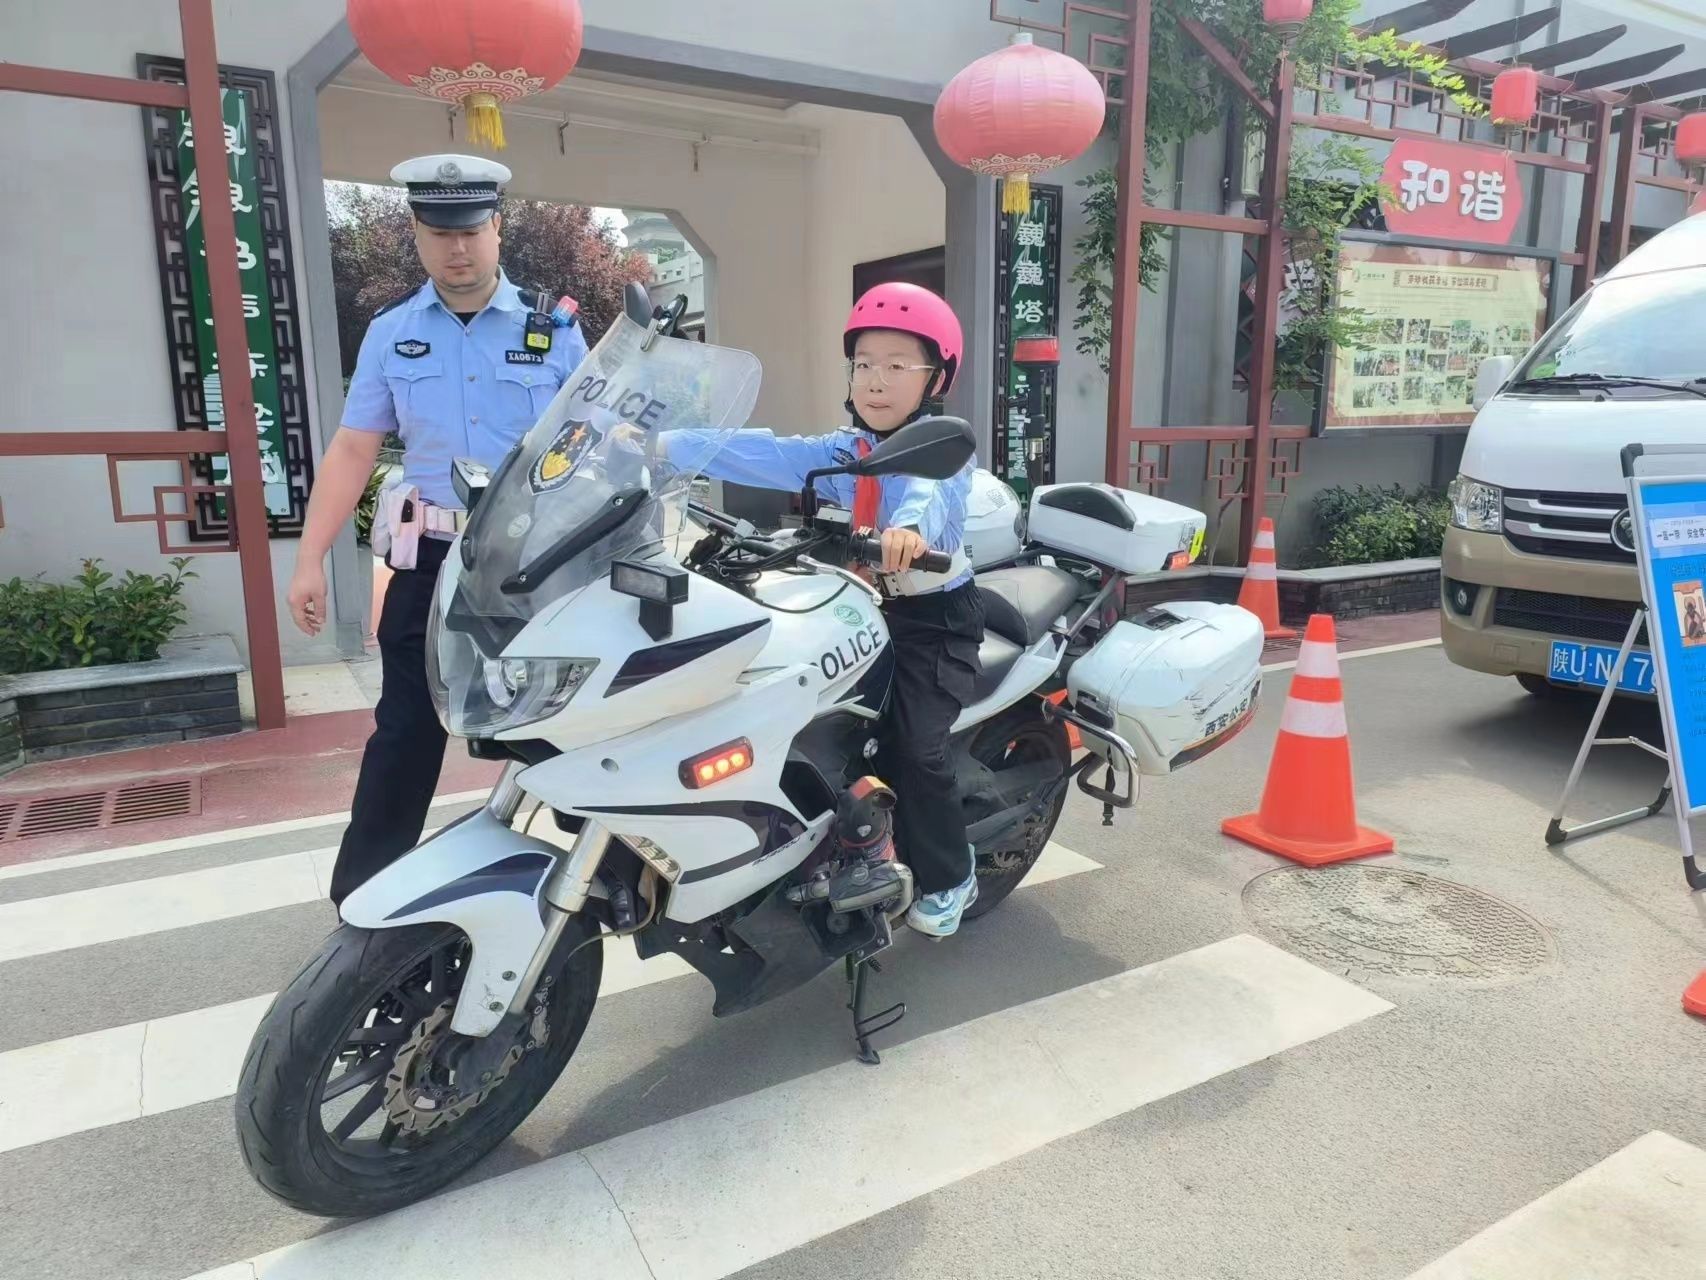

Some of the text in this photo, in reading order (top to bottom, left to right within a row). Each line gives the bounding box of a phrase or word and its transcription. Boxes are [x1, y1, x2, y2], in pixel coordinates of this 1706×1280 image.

[1400, 159, 1507, 222] 和谐
[570, 375, 667, 430] POLICE
[809, 621, 883, 680] OLICE
